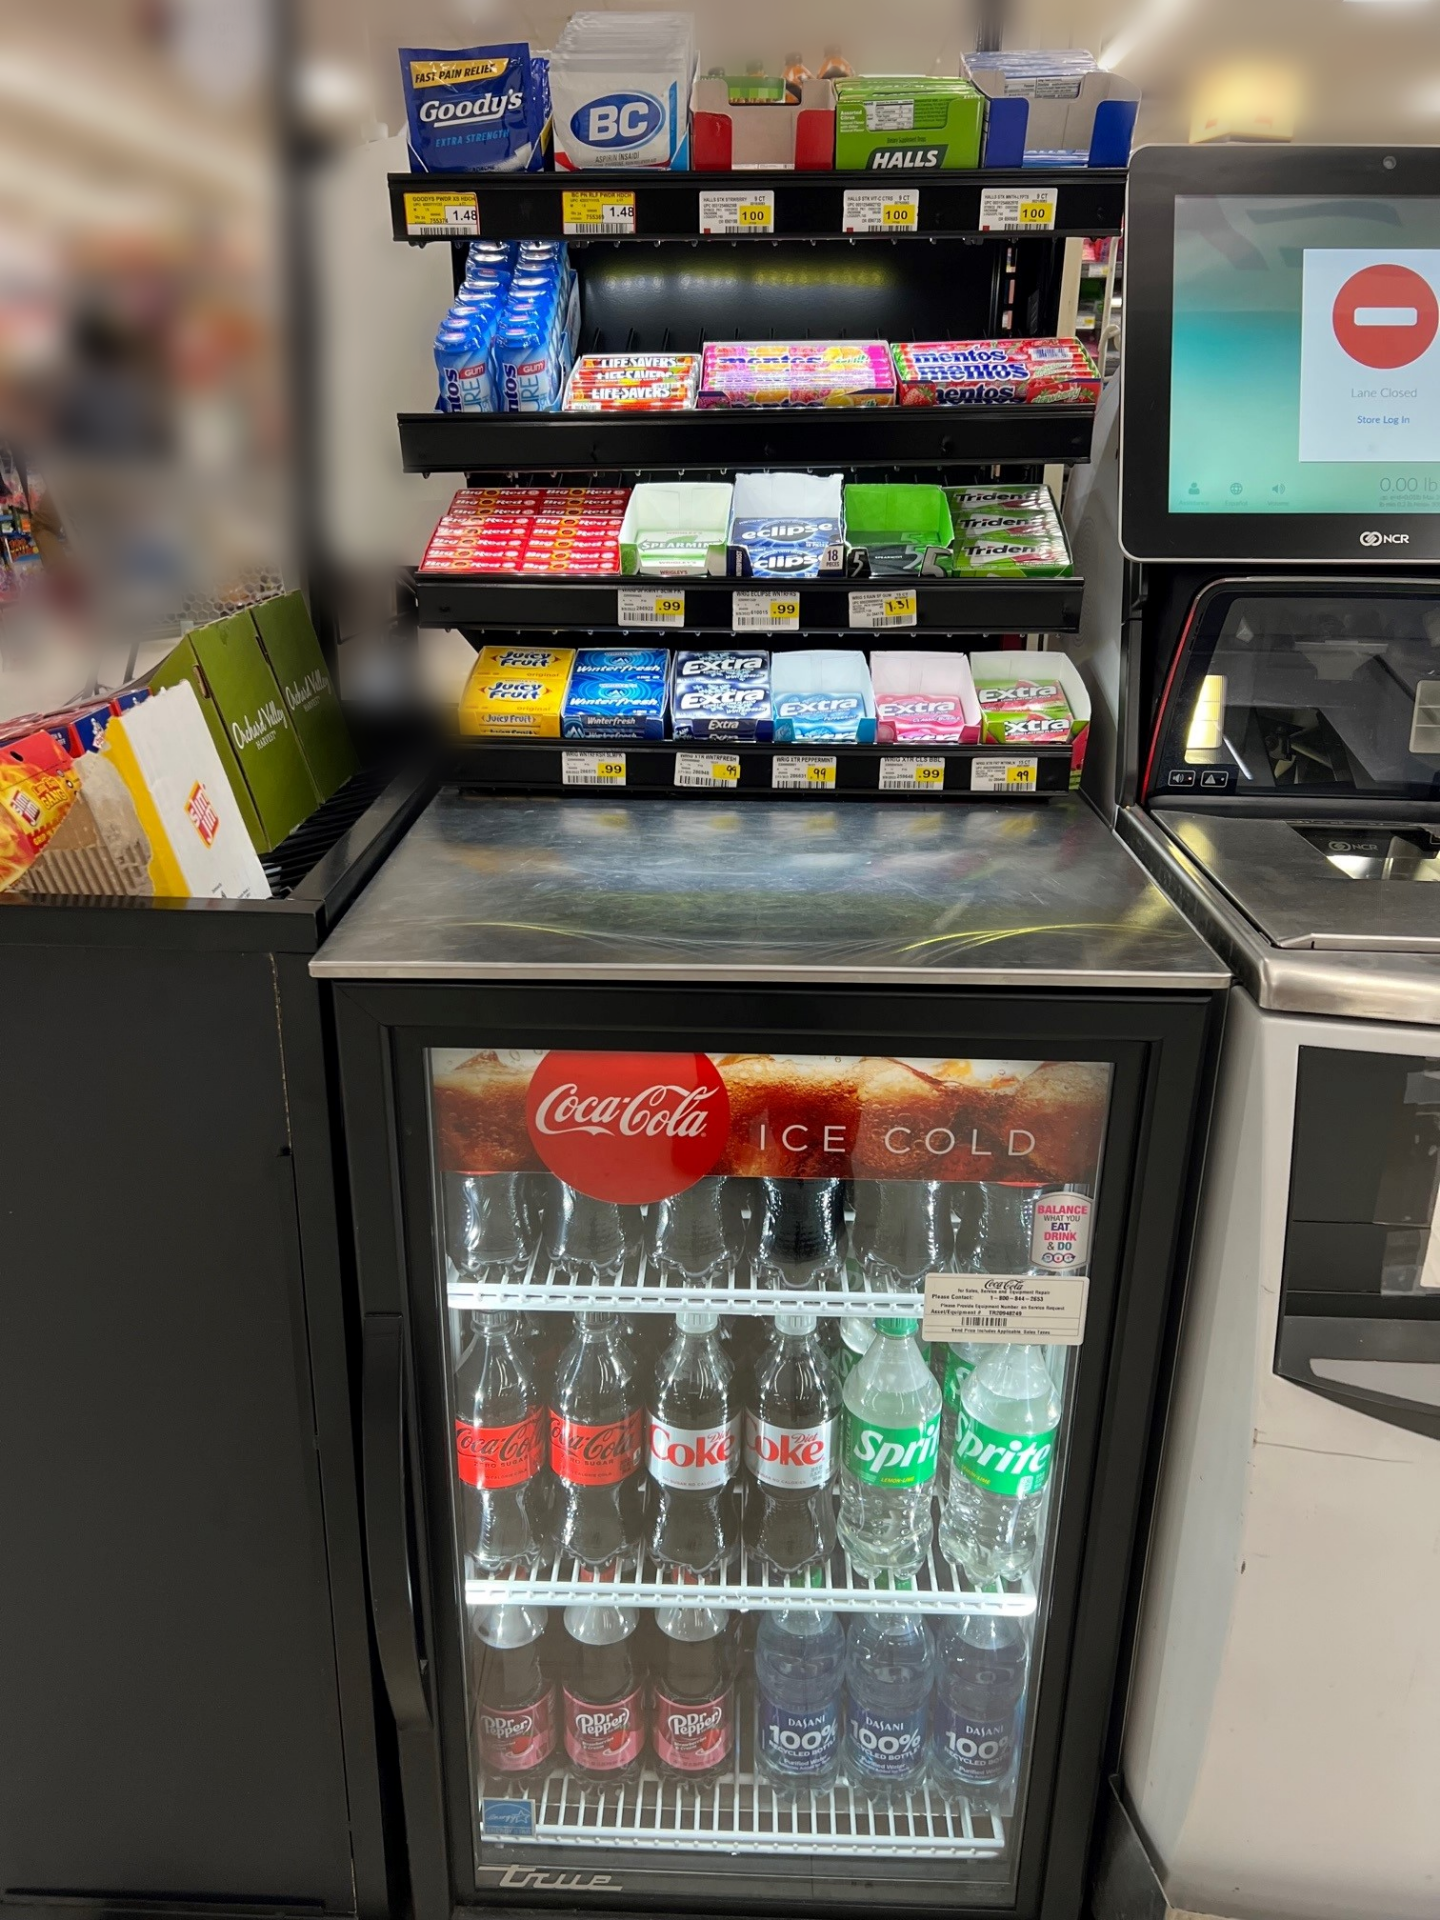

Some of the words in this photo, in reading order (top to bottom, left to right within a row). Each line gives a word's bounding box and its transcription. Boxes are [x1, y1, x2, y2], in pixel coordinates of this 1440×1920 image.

[414, 72, 436, 84] FAST
[439, 69, 462, 80] PAIN
[420, 89, 523, 127] Goody's
[588, 102, 649, 141] BC
[435, 136, 463, 148] EXTRA
[465, 129, 510, 144] STRENGTH
[595, 154, 617, 163] ASPIRIN
[872, 150, 938, 169] HALLS
[453, 210, 477, 221] 1.48
[609, 207, 634, 217] 1.48
[913, 345, 1007, 363] mentos
[918, 363, 1029, 380] mentos
[1351, 388, 1378, 398] Lane
[1381, 387, 1417, 398] Closed
[1357, 415, 1381, 424] Store
[1383, 415, 1399, 427] Log
[1401, 415, 1410, 424] In
[1379, 478, 1418, 492] 0.00
[1424, 477, 1438, 491] lb
[956, 492, 1028, 502] Triden
[960, 517, 1032, 528] Triden
[741, 523, 833, 540] eclipse
[1383, 534, 1410, 544] NCR
[641, 542, 710, 550] SPEARMIN
[963, 545, 1037, 555] Triden
[827, 550, 838, 561] 18
[752, 555, 822, 570] clips
[658, 601, 681, 611] .99
[773, 604, 795, 614] .99
[499, 651, 551, 659] Juicy
[500, 659, 549, 667] Fruit
[683, 657, 763, 676] Extra
[488, 682, 542, 690] Juicy
[489, 690, 540, 699] Fruit
[681, 689, 765, 710] Extra
[980, 686, 1057, 703] Extra
[570, 698, 658, 706] Winterfresh
[780, 699, 857, 716] Extra
[879, 701, 955, 717] Extra
[232, 709, 267, 749] Orchard
[261, 700, 288, 729] Valley
[486, 714, 508, 723] Juicy
[510, 715, 531, 723] Fruit
[587, 717, 636, 725] Winterfresh
[708, 720, 739, 730] Extra
[1006, 719, 1070, 732] xtra
[256, 730, 276, 750] HARVEST
[601, 765, 622, 774] .99
[918, 769, 940, 778] .99
[1352, 842, 1378, 852] NCR
[535, 1083, 719, 1137] Coca-Cola
[760, 1124, 846, 1153] ICE
[885, 1127, 1036, 1157] COLD
[1037, 1205, 1088, 1215] BALANCE
[1044, 1232, 1077, 1241] DRINK
[1047, 1242, 1054, 1250] &
[1057, 1242, 1072, 1250] DO
[791, 1433, 818, 1446] Diet
[955, 1411, 1051, 1475] Sprite
[650, 1424, 735, 1468] Coke
[501, 1456, 528, 1468] SUGAR
[584, 1458, 615, 1466] SUGAR
[881, 1476, 915, 1484] LEMON-LIME
[577, 1714, 626, 1736] Pepper
[595, 1713, 614, 1726] Dr
[669, 1714, 718, 1736] Pepper
[687, 1713, 706, 1726] Dr
[788, 1715, 825, 1728] DASANI
[866, 1717, 904, 1731] DASANI
[769, 1719, 837, 1750] 100%
[851, 1720, 921, 1754] 100%
[966, 1725, 1004, 1737] DASANI
[784, 1756, 808, 1766] Purified
[478, 1864, 623, 1891] true
